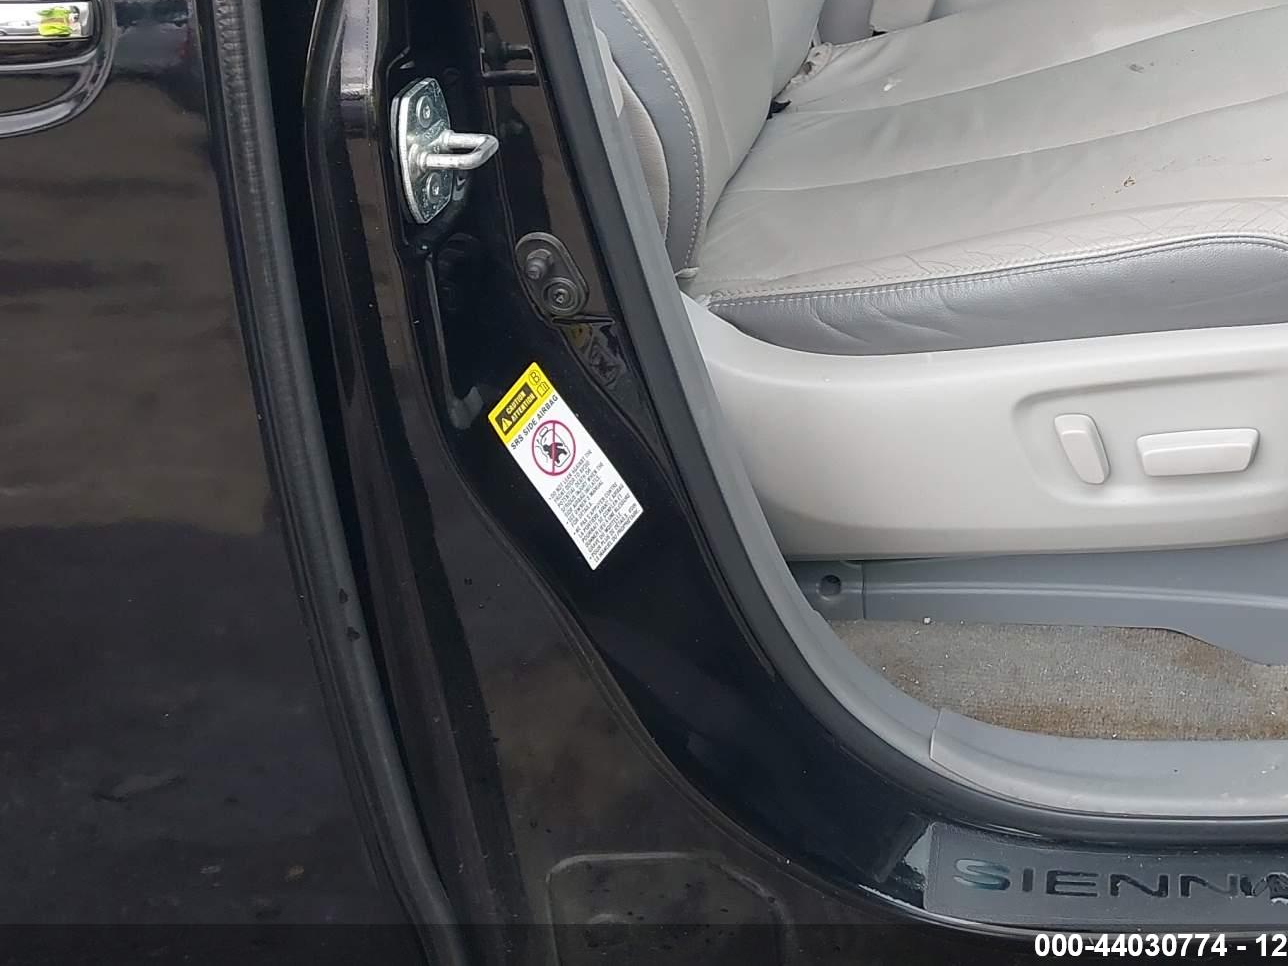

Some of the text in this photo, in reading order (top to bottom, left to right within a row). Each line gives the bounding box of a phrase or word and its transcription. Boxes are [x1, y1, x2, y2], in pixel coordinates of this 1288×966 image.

[506, 391, 527, 415] CAUTION
[511, 393, 535, 422] ATTENTION
[511, 394, 559, 450] SRS SIDE AIRBAG
